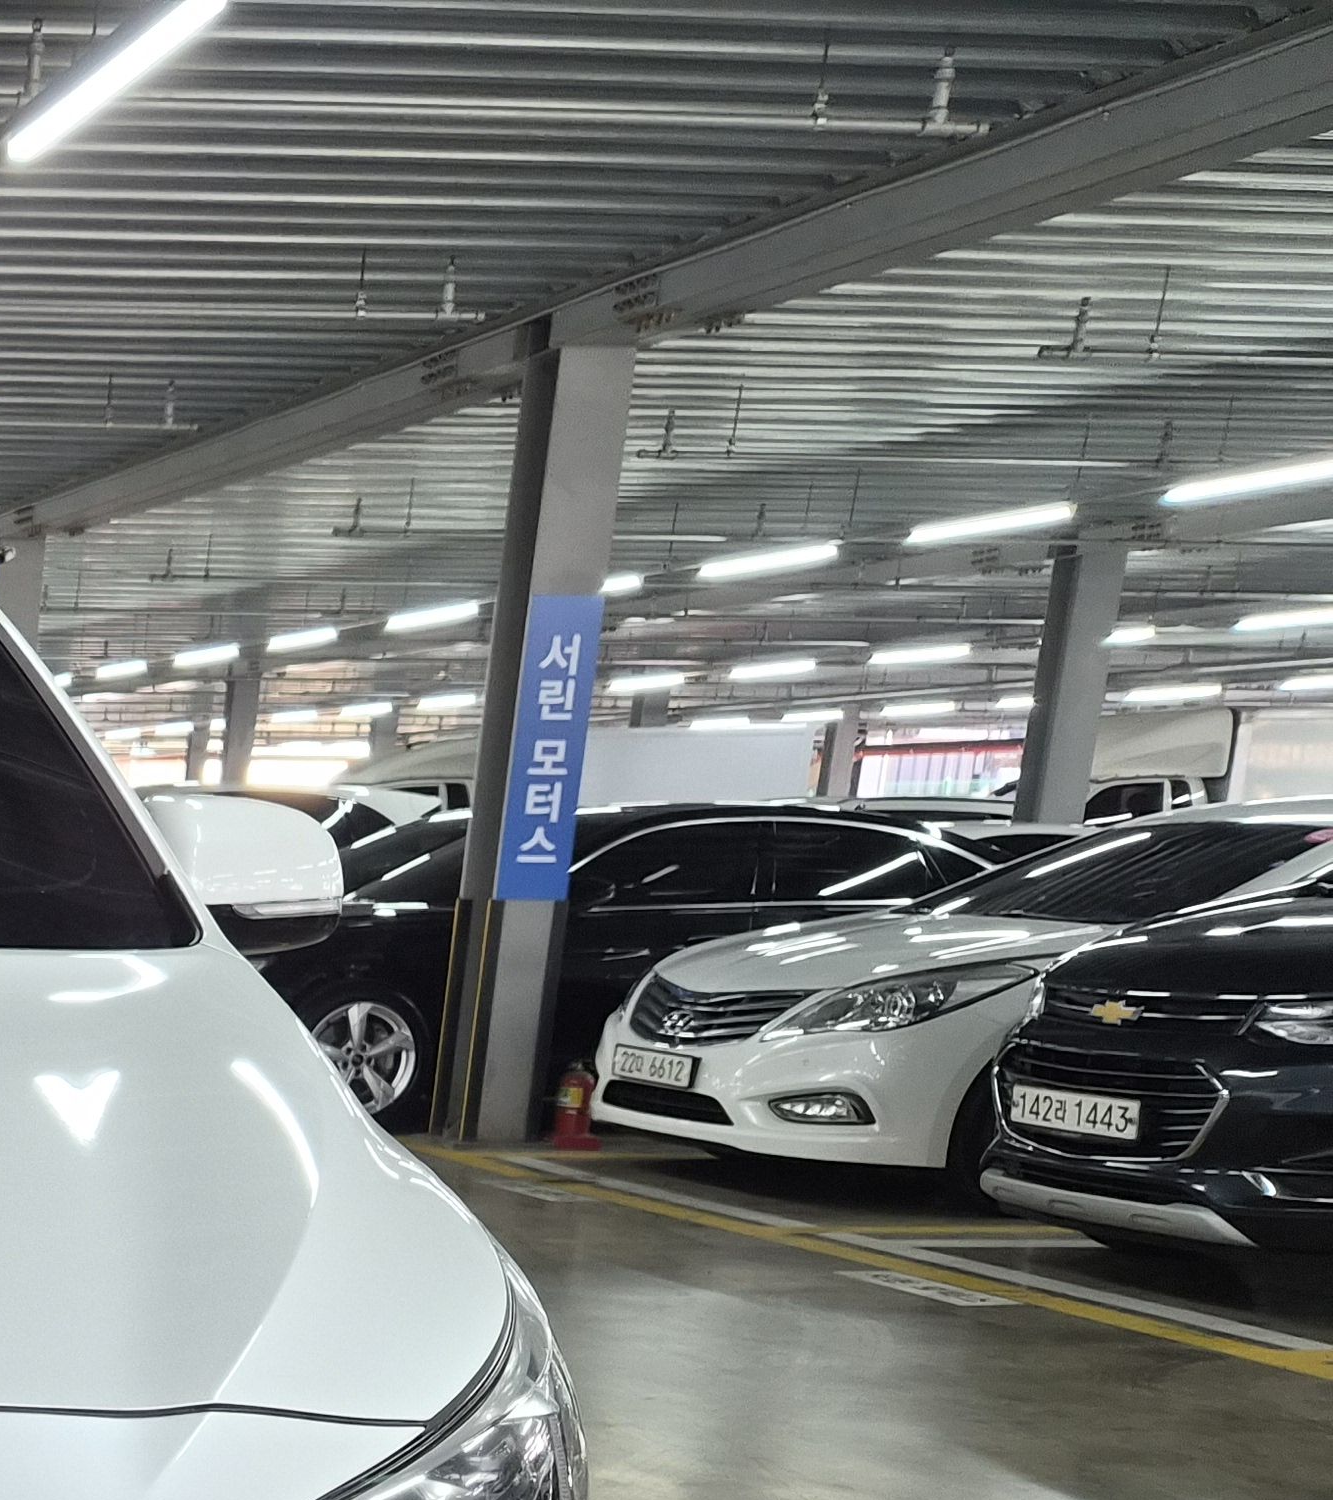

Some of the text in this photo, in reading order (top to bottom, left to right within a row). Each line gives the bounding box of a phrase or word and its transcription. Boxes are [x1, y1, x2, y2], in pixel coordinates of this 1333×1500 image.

[515, 633, 582, 865] 서린 모터스
[649, 1056, 685, 1082] 6612
[1019, 1091, 1130, 1133] 142라 1443
